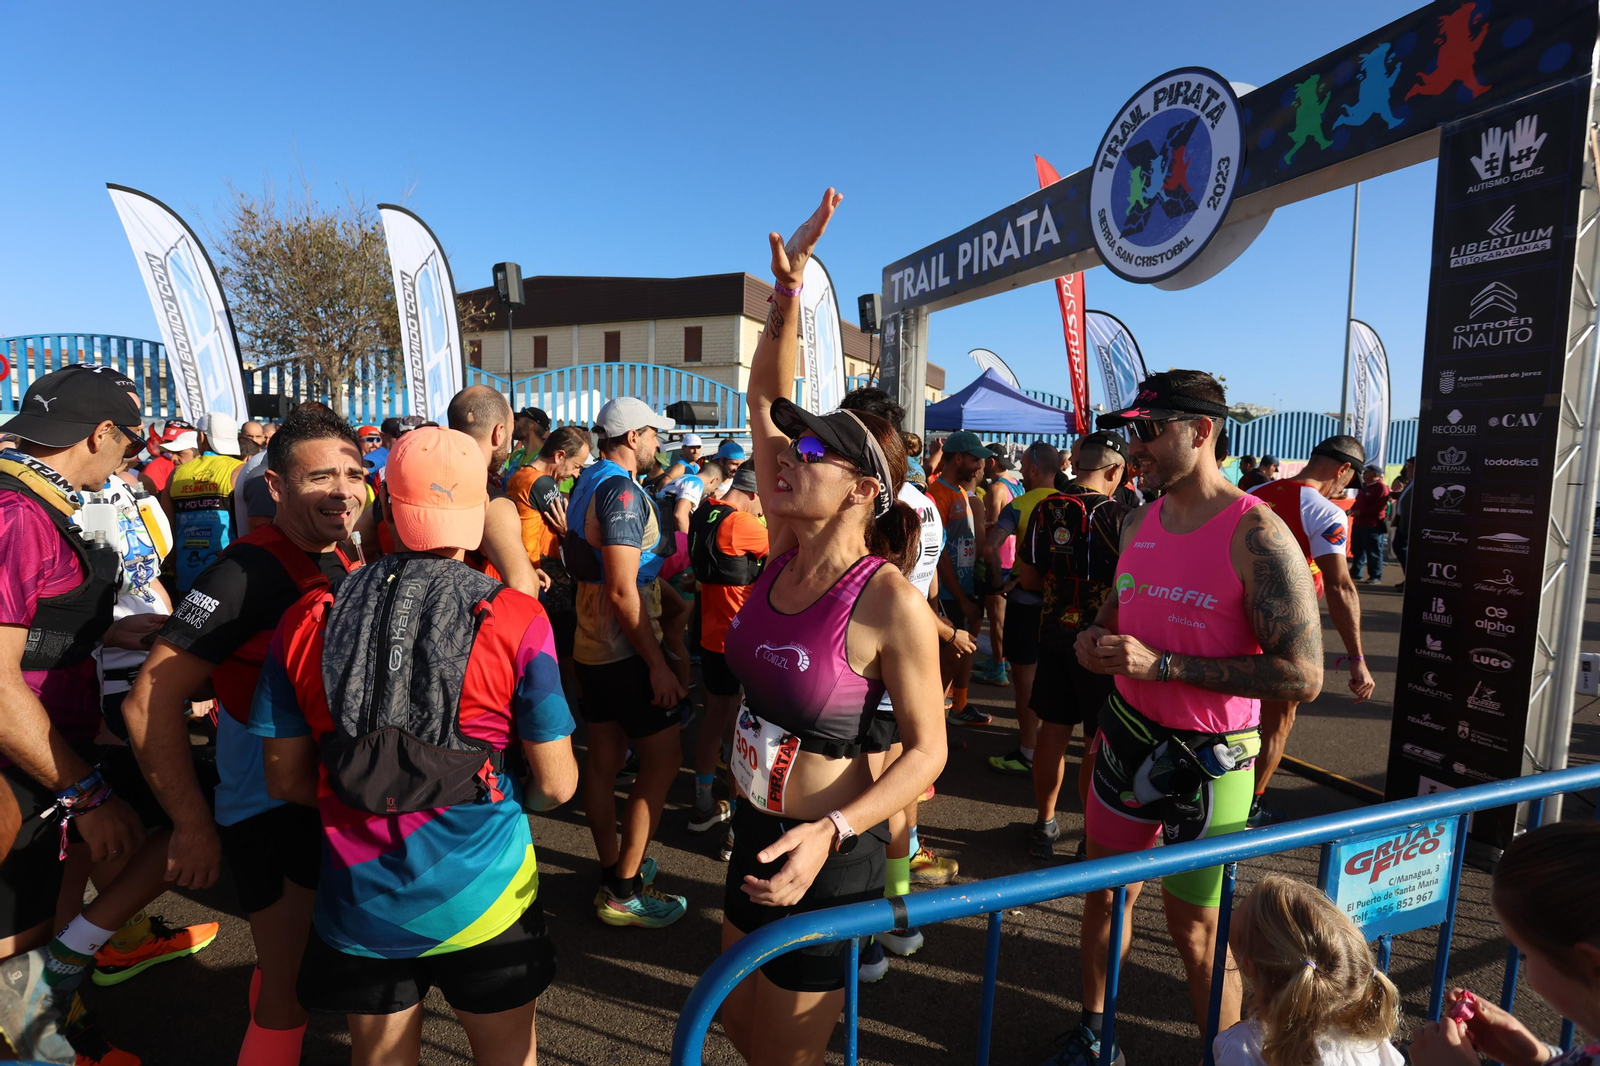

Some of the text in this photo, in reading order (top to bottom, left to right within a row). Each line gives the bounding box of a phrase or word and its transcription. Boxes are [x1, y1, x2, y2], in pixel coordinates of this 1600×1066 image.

[1099, 80, 1227, 172] TRAIL PIRATA
[1206, 156, 1231, 211] 2023
[1466, 166, 1545, 194] AUTISMO CÁDIZ
[1097, 207, 1195, 267] SIERRA SAN CRISTOBAL
[1450, 225, 1554, 258] LIBERTIUM
[891, 203, 1061, 304] TRAIL PIRATA
[1451, 242, 1549, 267] AUTOCARAVANAS
[1452, 327, 1534, 350] INAUTO
[1458, 372, 1509, 382] Ayuntamiento
[1432, 424, 1477, 434] RECOSUR
[1501, 413, 1543, 427] CAV
[26, 459, 74, 493] TEAM
[1134, 541, 1156, 549] FASTER
[1427, 562, 1457, 580] TC
[185, 588, 220, 613] 226ERS
[190, 605, 211, 620] YOUR
[391, 579, 422, 640] kalenji
[1168, 614, 1207, 629] chiclana
[1422, 611, 1453, 625] BAMBÚ
[1475, 619, 1516, 634] alpha
[1415, 648, 1452, 662] UMBRA
[1472, 654, 1513, 669] LUGO
[1407, 682, 1453, 700] FANAUTIC
[1407, 715, 1446, 731] TEAMERGY
[736, 729, 758, 770] 390
[769, 745, 795, 803] PIRATA
[1096, 769, 1119, 794] chiclana
[1344, 821, 1447, 875] GRUAS
[1368, 838, 1440, 884] FICO
[1388, 864, 1440, 886] C/Managua, 3
[1346, 903, 1354, 912] El
[1356, 896, 1382, 909] Puerto
[1384, 890, 1393, 901] de
[1394, 884, 1416, 897] Santa
[1376, 903, 1394, 916] 956
[1396, 896, 1414, 910] 852
[1415, 890, 1433, 904] 967
